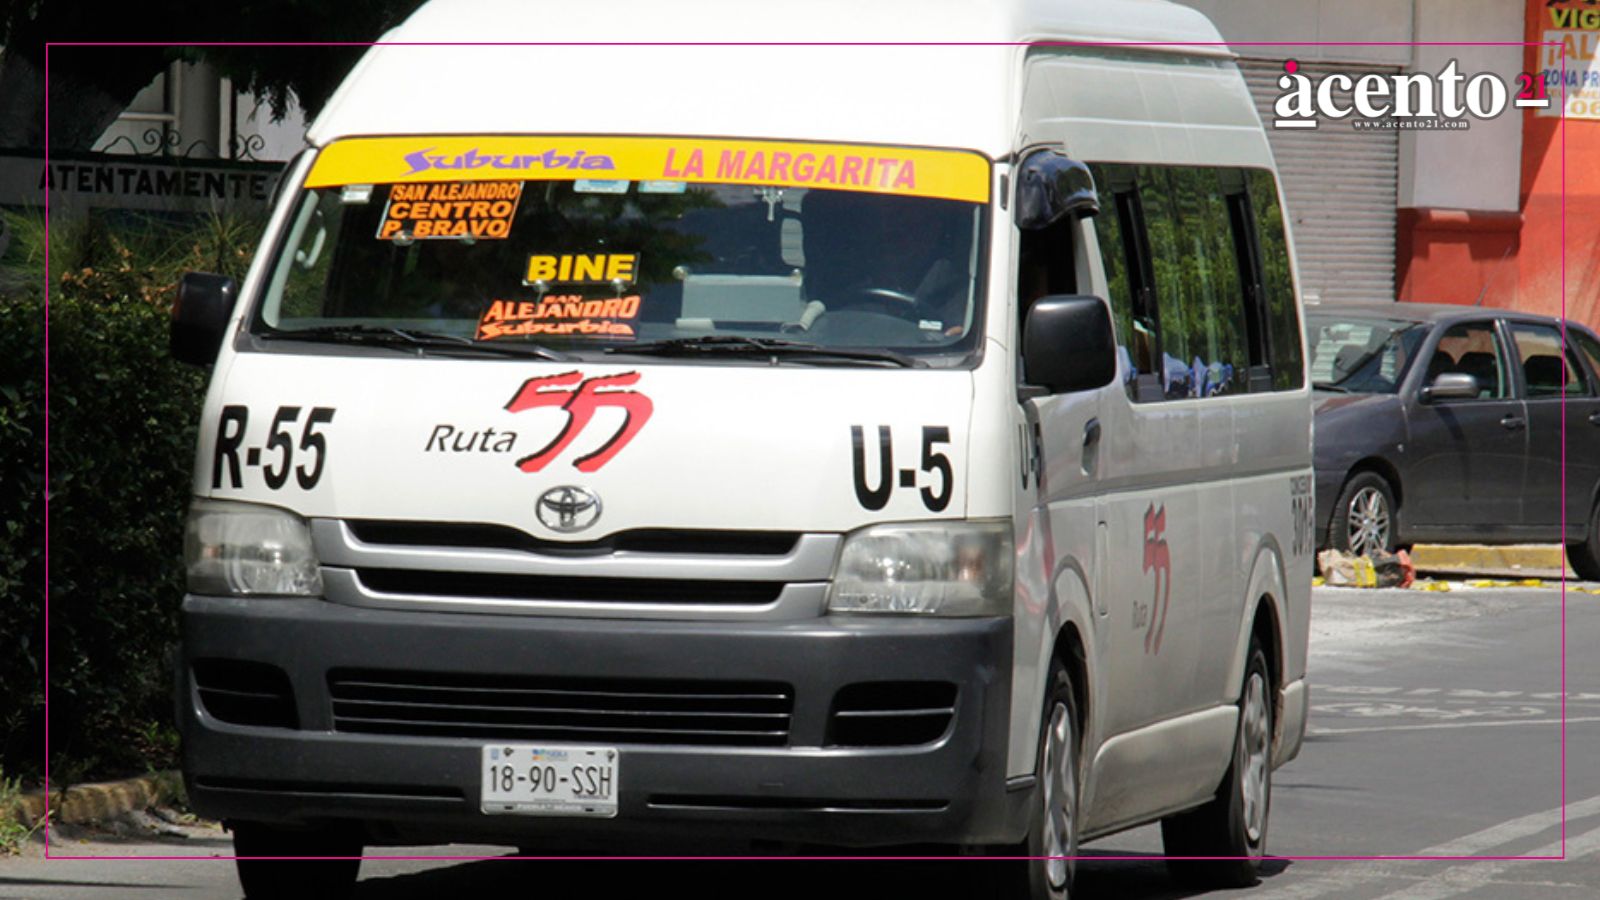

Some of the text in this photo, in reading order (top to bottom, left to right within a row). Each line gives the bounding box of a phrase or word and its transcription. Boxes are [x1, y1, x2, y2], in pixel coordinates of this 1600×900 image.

[405, 148, 615, 176] Suburbia
[663, 148, 916, 189] LA MARGARITA
[39, 165, 266, 197] ATENTAMENTE
[393, 182, 519, 200] SAN ALEJANDRO
[389, 201, 512, 219] CENTRO
[413, 219, 508, 238] BRAVO
[526, 254, 635, 282] BINE
[483, 296, 641, 321] ALEJANDRO
[479, 320, 634, 341] Suburbia
[425, 370, 653, 472] Ruta 55
[212, 405, 336, 491] R-55
[851, 425, 953, 512] U-5
[490, 765, 612, 796] 18-90-SSH
